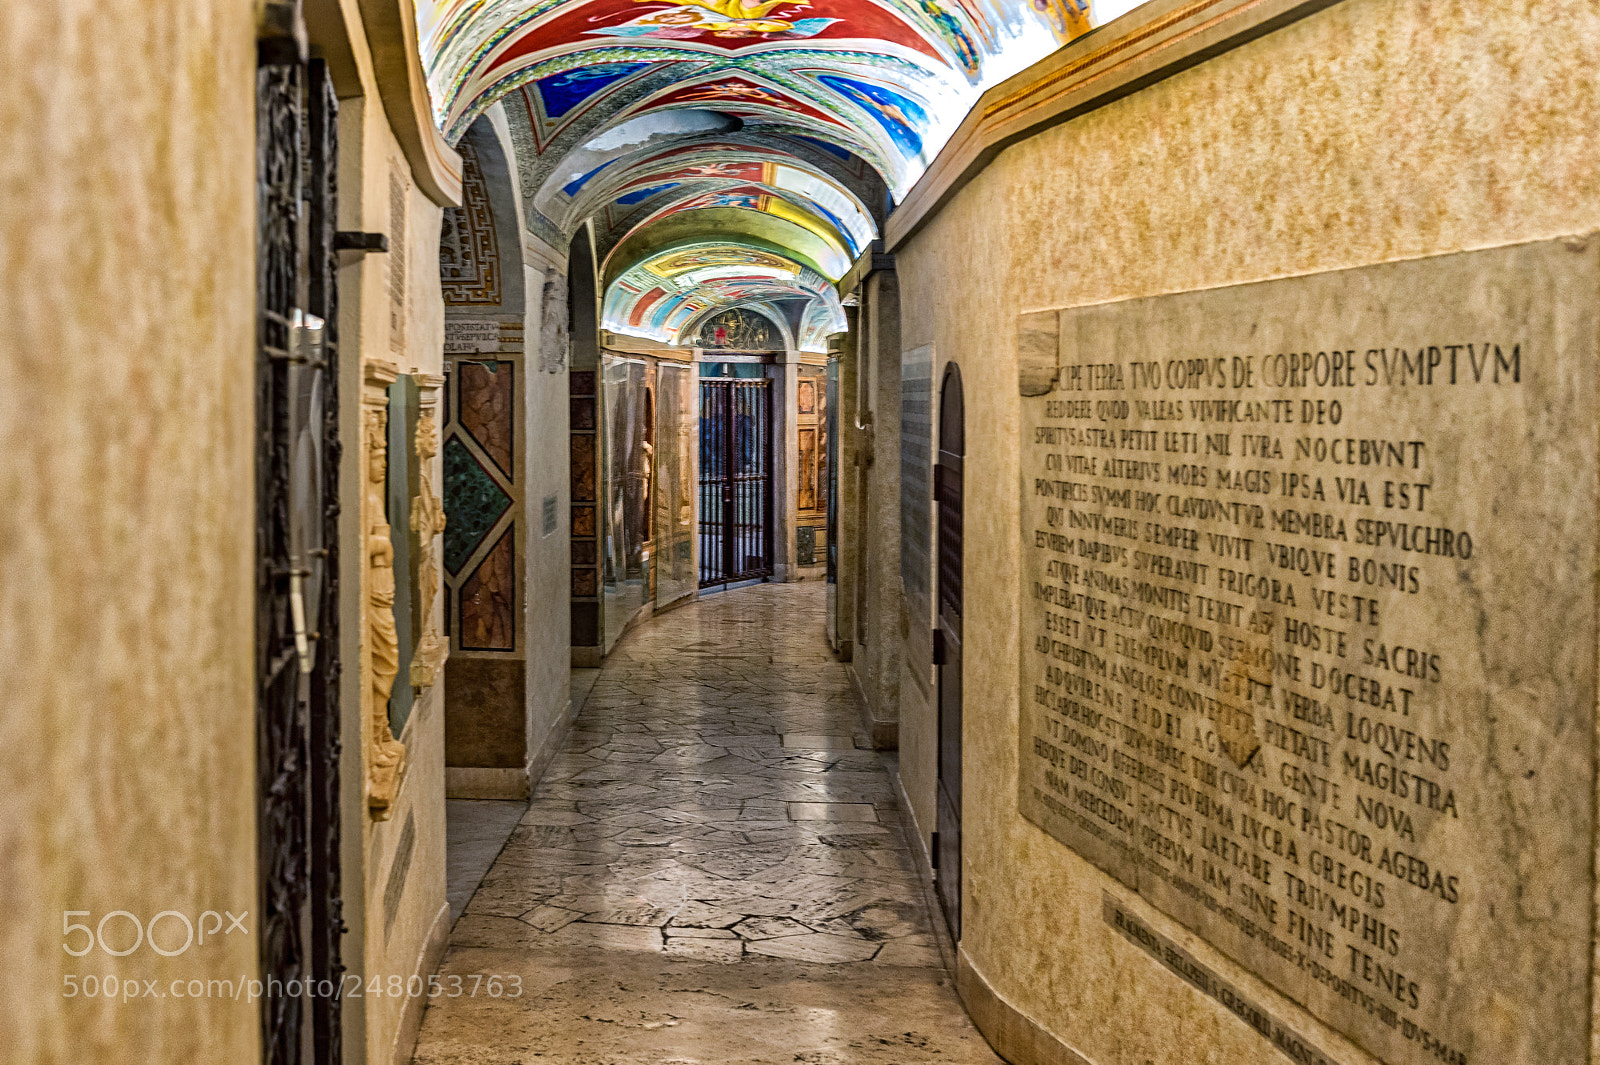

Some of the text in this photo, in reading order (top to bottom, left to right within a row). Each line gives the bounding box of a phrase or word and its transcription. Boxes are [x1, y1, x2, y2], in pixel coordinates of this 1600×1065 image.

[1129, 361, 1161, 389] TVO
[1166, 358, 1227, 388] CORPVS
[1231, 356, 1254, 388] DE
[1261, 352, 1355, 387] CORPORE
[1364, 344, 1522, 386] SVMPTVM
[1300, 401, 1342, 425] DEO
[1065, 454, 1096, 475] VITAE
[1102, 457, 1160, 482] ALTERIVS
[1167, 463, 1207, 487] MORS
[1215, 467, 1271, 494] MAGIS
[1280, 473, 1325, 501] IPSA
[1334, 478, 1370, 506] VIA
[1383, 482, 1430, 512] EST
[1077, 427, 1115, 448] ASTRA
[1120, 429, 1158, 451] PETIT
[1164, 431, 1197, 454] LETI
[1205, 433, 1231, 457] NIL
[1295, 437, 1425, 471] NOCEBVNT
[1144, 522, 1199, 552] SEMPER
[1206, 532, 1253, 563] VIVIT
[1265, 542, 1336, 581] VBIQVE
[1347, 556, 1420, 595] BONIS
[1270, 507, 1348, 542] MEMBRA
[1354, 518, 1473, 561] SEPVLCHRO
[1217, 567, 1296, 607] FRIGORA
[1311, 587, 1379, 627] VESTE
[1283, 617, 1346, 658] HOSTE
[1362, 637, 1441, 685] SACRIS
[1311, 661, 1414, 718] DOCEBAT
[1346, 710, 1451, 778] LOQVENS
[1280, 759, 1341, 810] GENTE
[1355, 791, 1416, 843] NOVA
[1343, 747, 1459, 819] MAGISTRA
[1241, 812, 1300, 865] LVCRA
[1308, 845, 1385, 909] GREGIS
[1261, 787, 1295, 827] HOC
[1300, 805, 1374, 864] PASTOR
[1377, 840, 1459, 906] AGEBAS
[1239, 879, 1277, 925] SINE
[1287, 907, 1334, 959] FINE
[1345, 941, 1420, 1011] TENES
[1283, 869, 1400, 958] TRIVMPHIS
